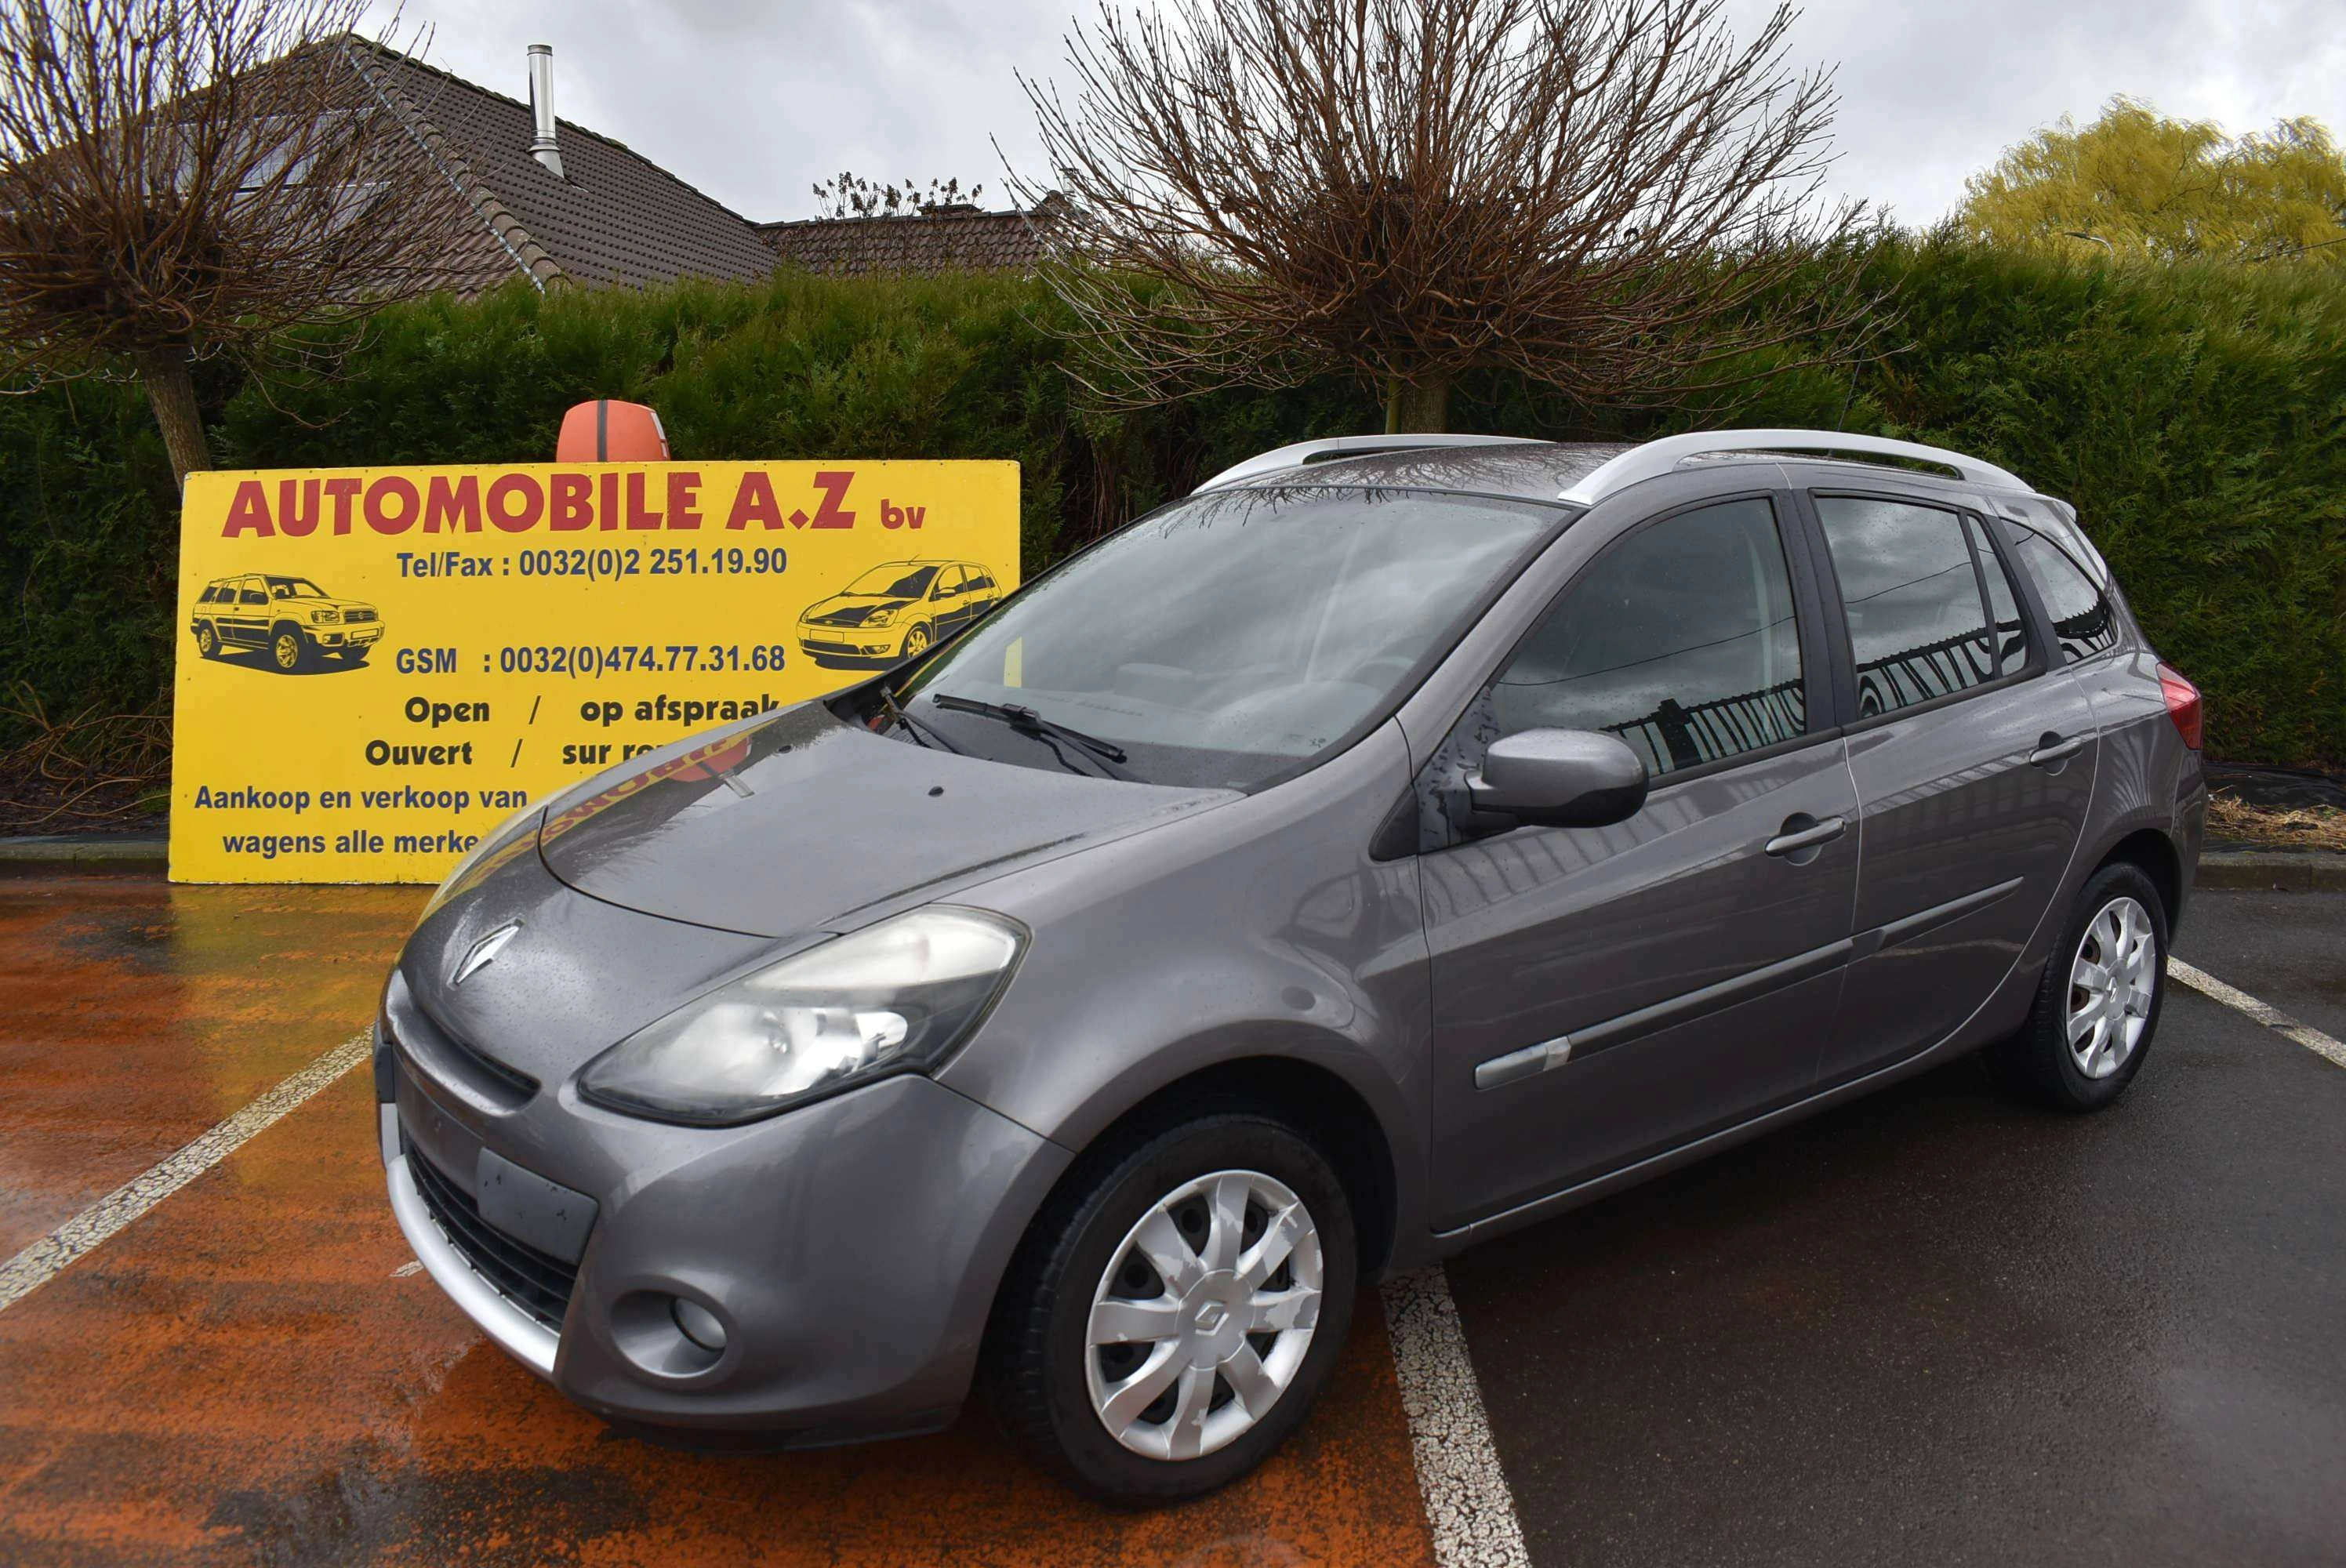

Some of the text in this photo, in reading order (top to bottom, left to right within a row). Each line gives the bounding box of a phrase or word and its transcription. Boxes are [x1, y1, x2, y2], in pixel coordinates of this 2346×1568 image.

[221, 472, 925, 537] AUTOMOBILE A.Z bv
[397, 552, 492, 577] Tel/Fax
[520, 549, 639, 582] 0032(0)2
[650, 548, 786, 574] 251.19.90
[397, 648, 456, 673] GSM
[501, 645, 784, 679] 0032(0)474.77.31.68
[405, 694, 779, 728] Open / op afspraak
[365, 740, 472, 765] Ouvert
[511, 739, 523, 768] /
[563, 745, 612, 764] sur
[194, 786, 527, 815] Aankoop en verkoop van
[223, 836, 325, 859] wagens
[336, 830, 383, 853] alle
